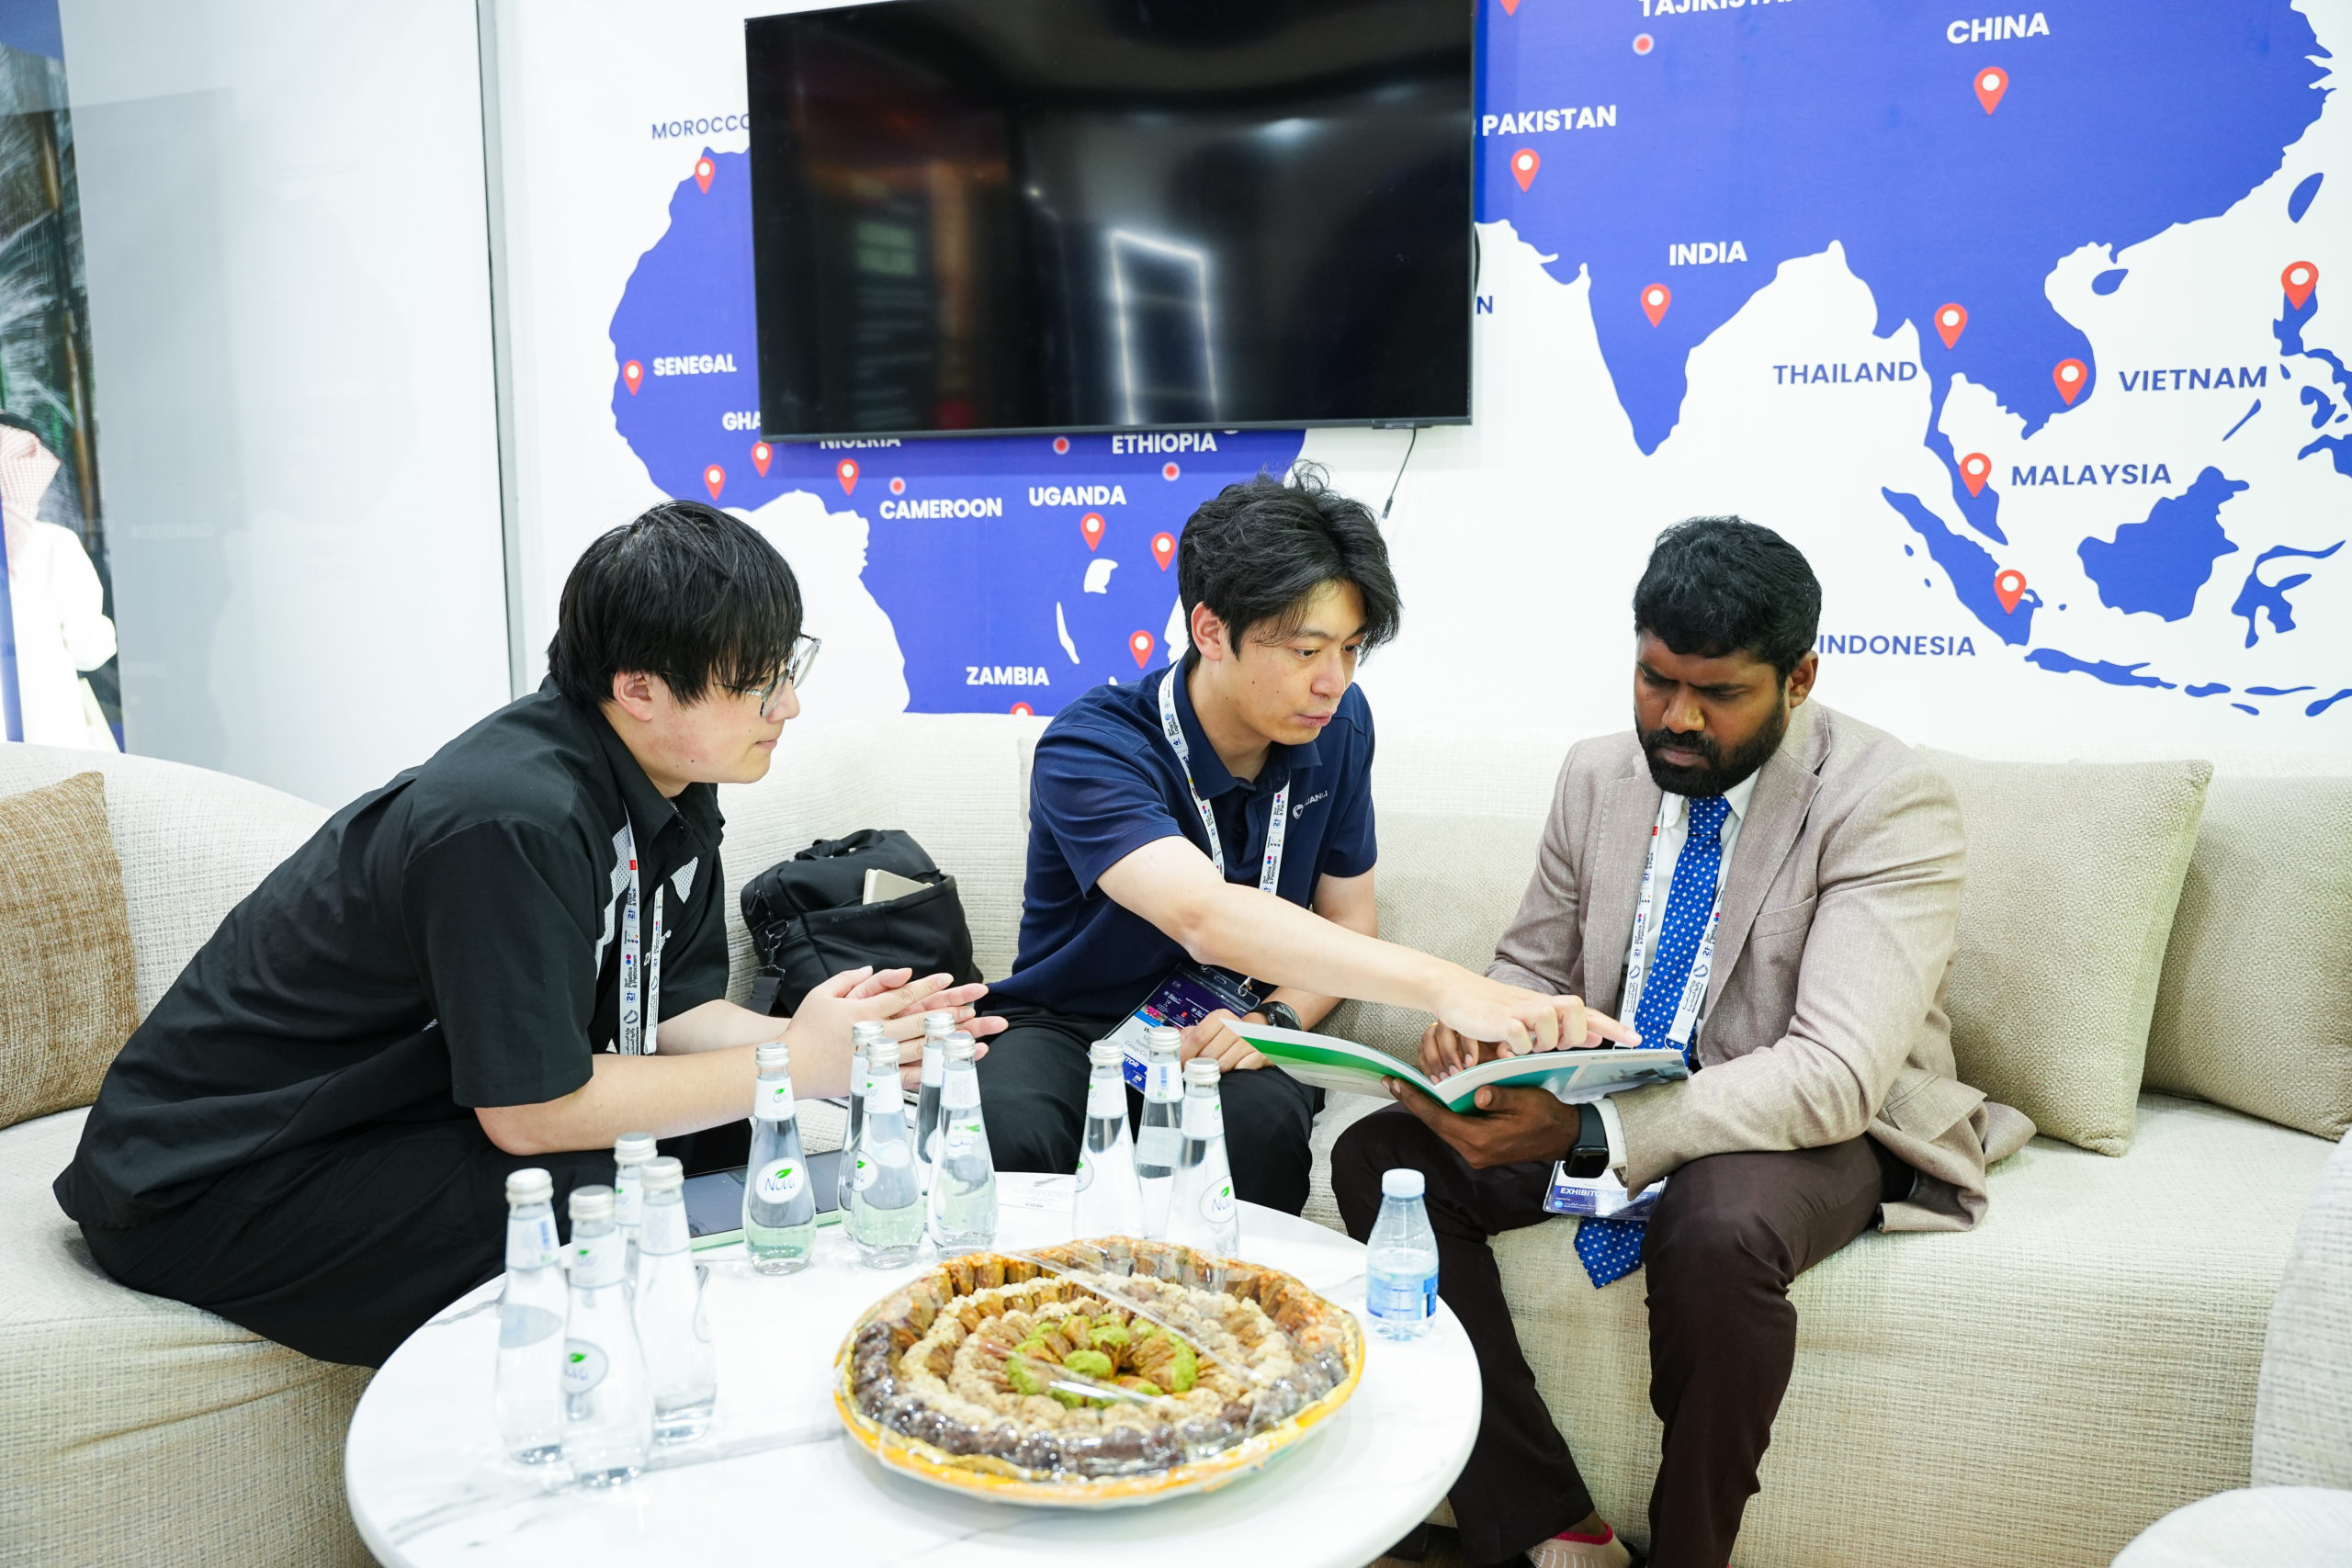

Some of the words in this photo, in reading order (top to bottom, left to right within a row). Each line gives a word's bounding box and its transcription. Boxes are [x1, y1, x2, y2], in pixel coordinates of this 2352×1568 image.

[1946, 12, 2050, 44] CHINA
[1482, 104, 1617, 137] PAKISTAN
[1668, 240, 1747, 266] INDIA
[652, 353, 738, 377] SENEGAL
[1772, 361, 1918, 385] THAILAND
[2118, 366, 2267, 392] VIETNAM
[721, 411, 761, 431] GHA
[1112, 433, 1217, 455] ETHIOPIA
[2011, 463, 2172, 487] MALAYSIA
[1028, 485, 1127, 507] UGANDA
[879, 497, 1002, 520] CAMEROON
[1818, 634, 1976, 657] INDONESIA
[966, 666, 1050, 686] ZAMBIA
